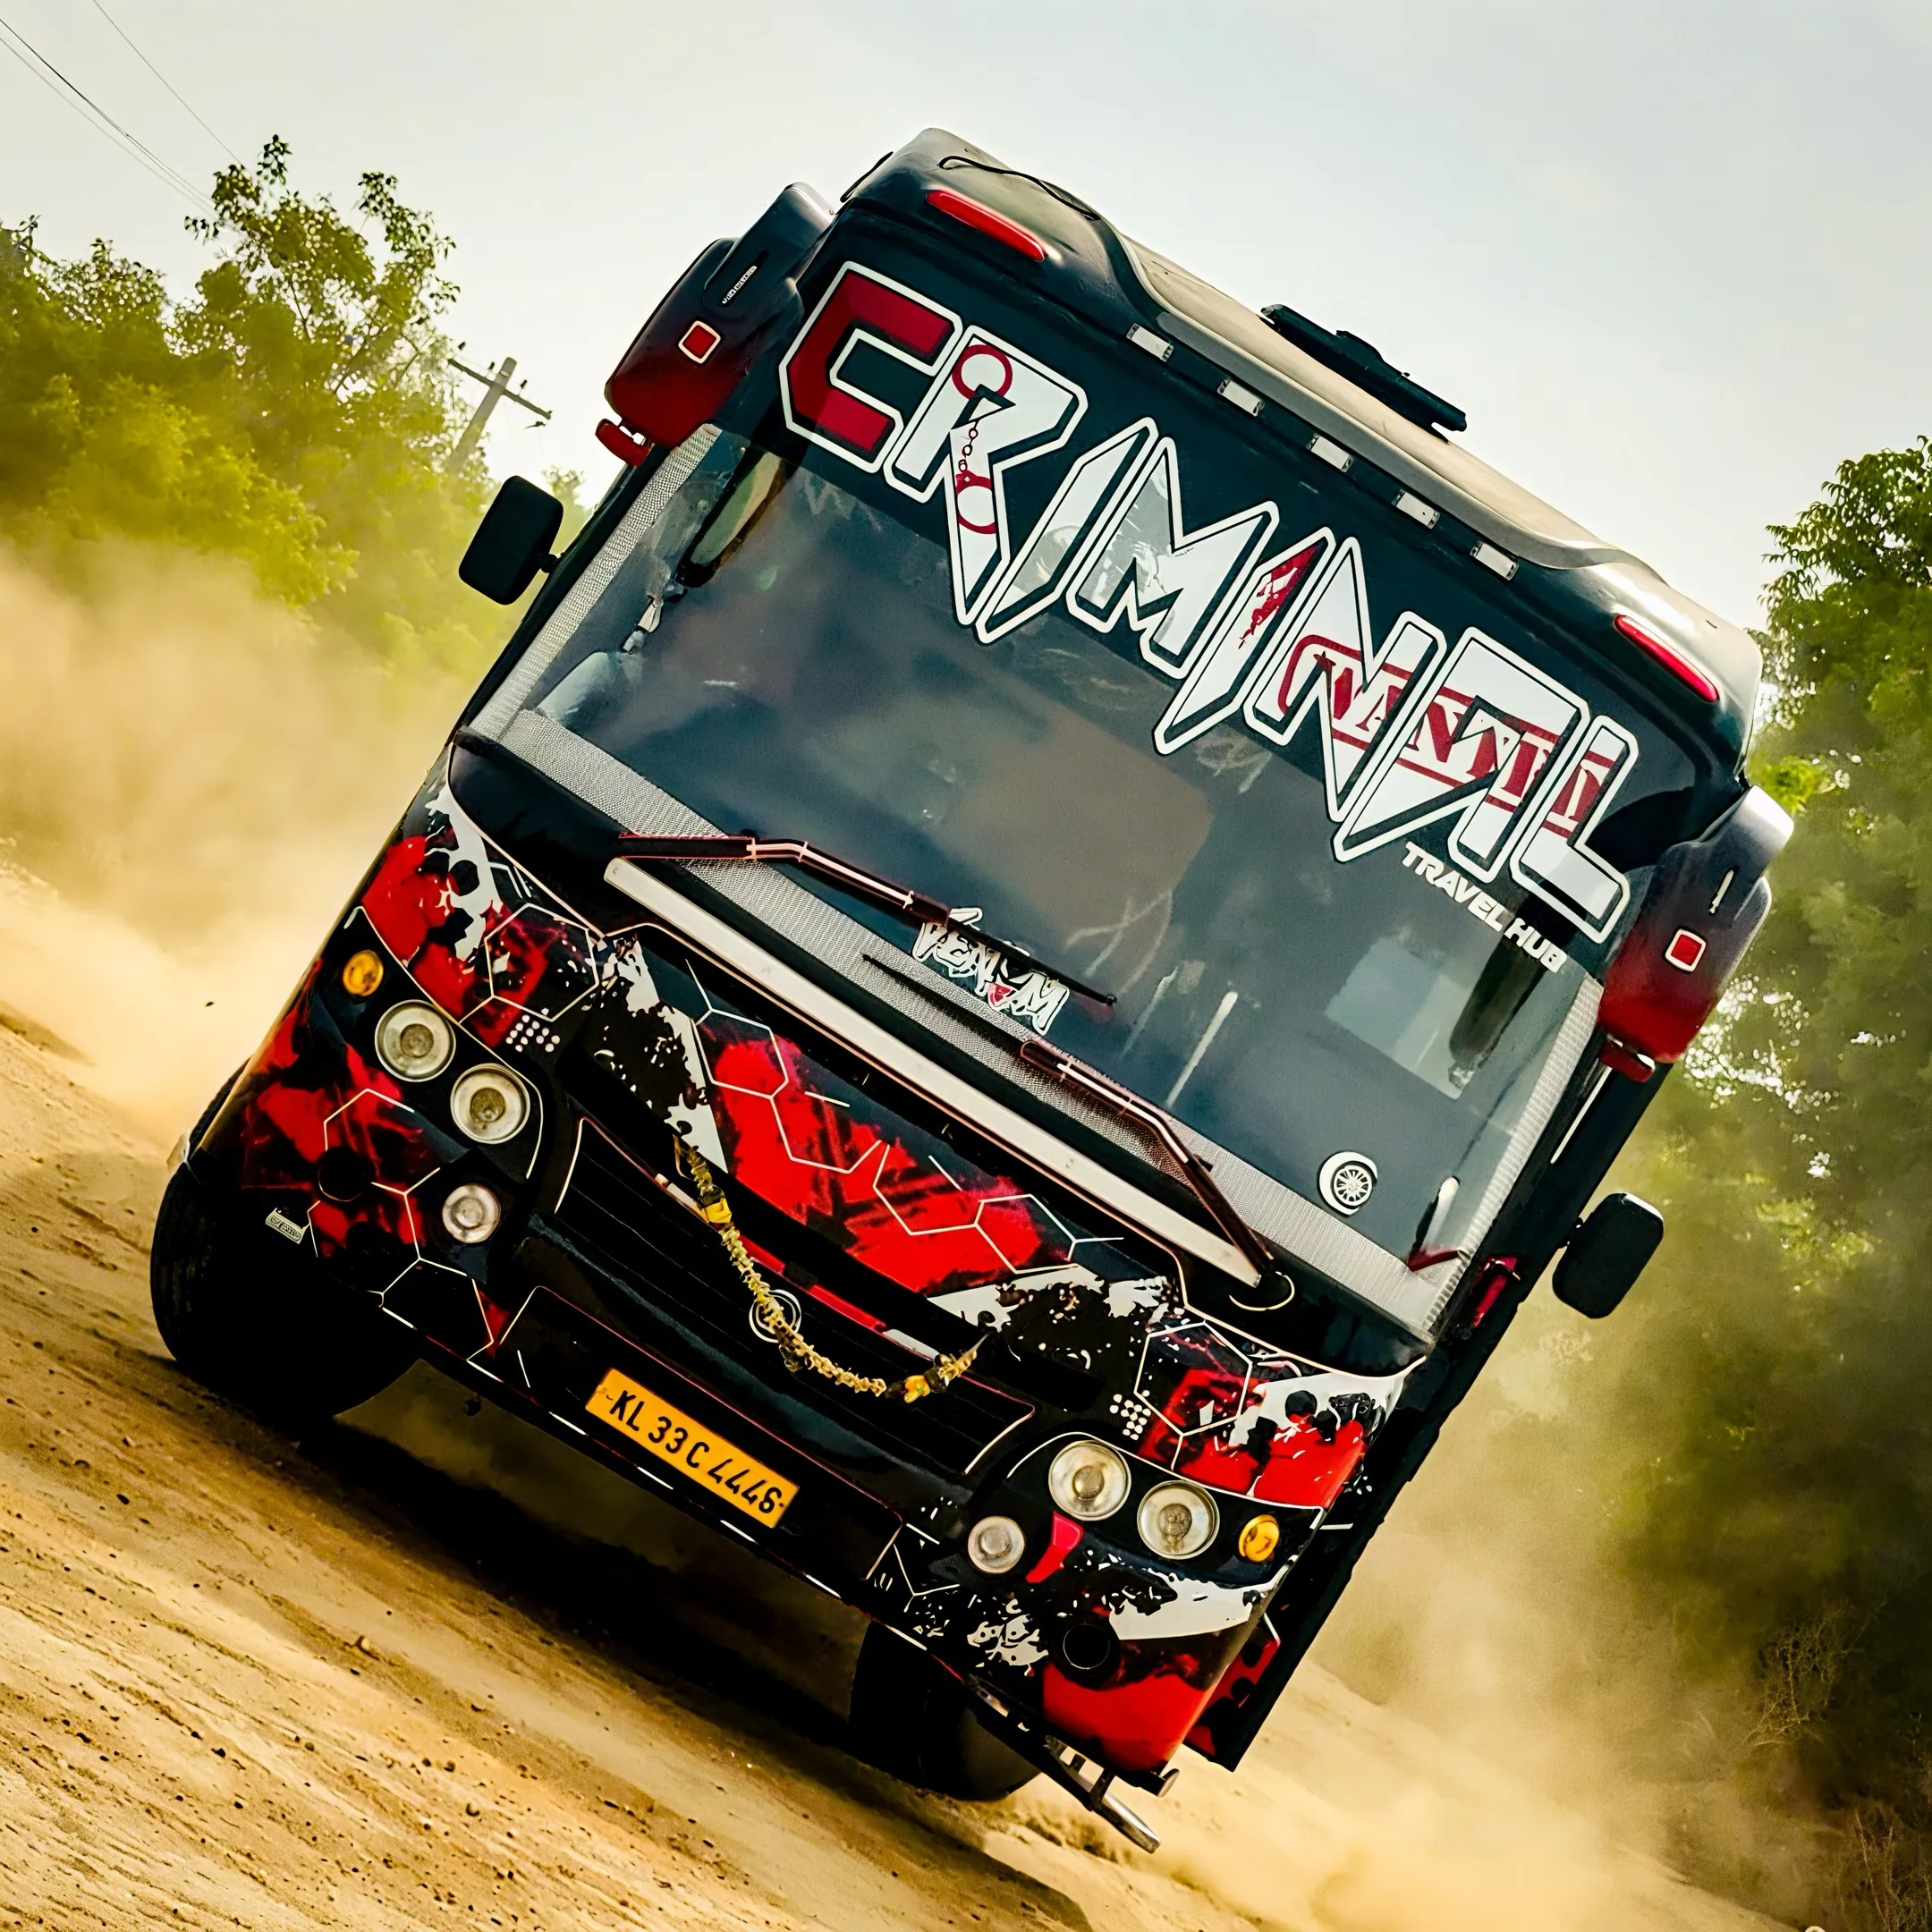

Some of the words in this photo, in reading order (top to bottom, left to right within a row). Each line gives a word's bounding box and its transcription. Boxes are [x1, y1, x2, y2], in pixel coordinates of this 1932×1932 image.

[778, 260, 1637, 945] CRIMINAL
[1402, 843, 1505, 933] TRAVEL
[1506, 918, 1567, 973] HUB
[609, 1390, 644, 1431] KL
[648, 1416, 687, 1453] 33
[686, 1442, 709, 1468] C
